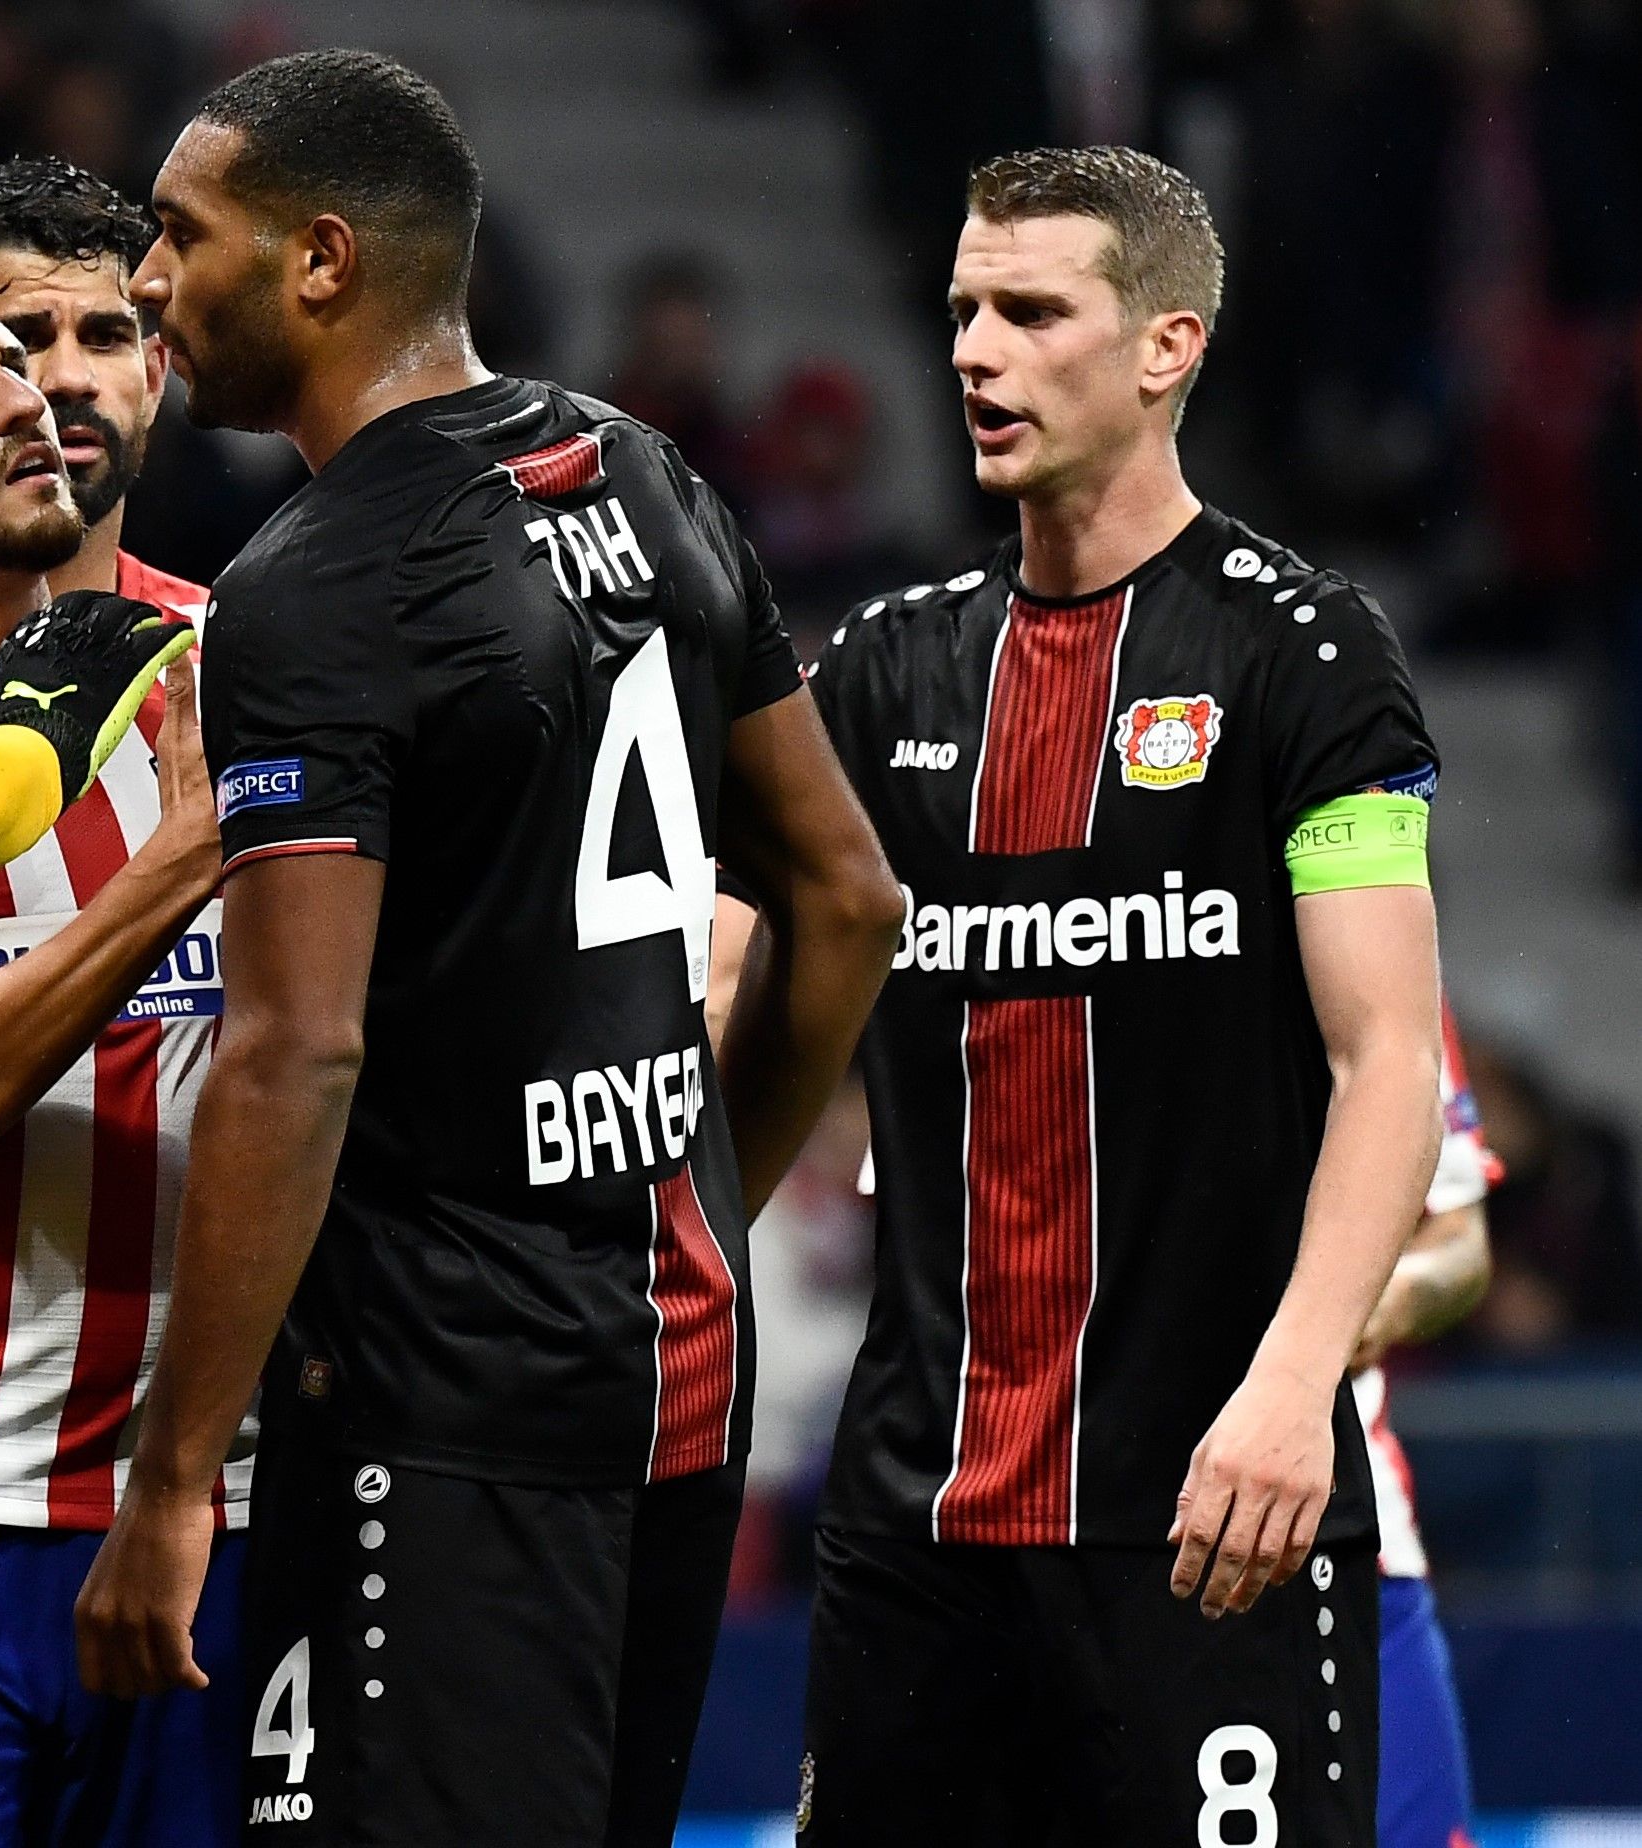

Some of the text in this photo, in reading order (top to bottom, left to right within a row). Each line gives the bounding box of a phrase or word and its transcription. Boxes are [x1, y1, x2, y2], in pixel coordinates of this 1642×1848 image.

[524, 498, 655, 600] TAH
[889, 739, 959, 771] JAKO
[1132, 766, 1198, 782] Leverkusen
[575, 626, 716, 1003] 4
[1286, 822, 1356, 853] SPECT
[891, 870, 1241, 971] Barmenia
[127, 996, 194, 1017] Online
[251, 1636, 316, 1784] 4
[249, 1792, 314, 1825] JAKO
[1197, 1724, 1279, 1848] 8
